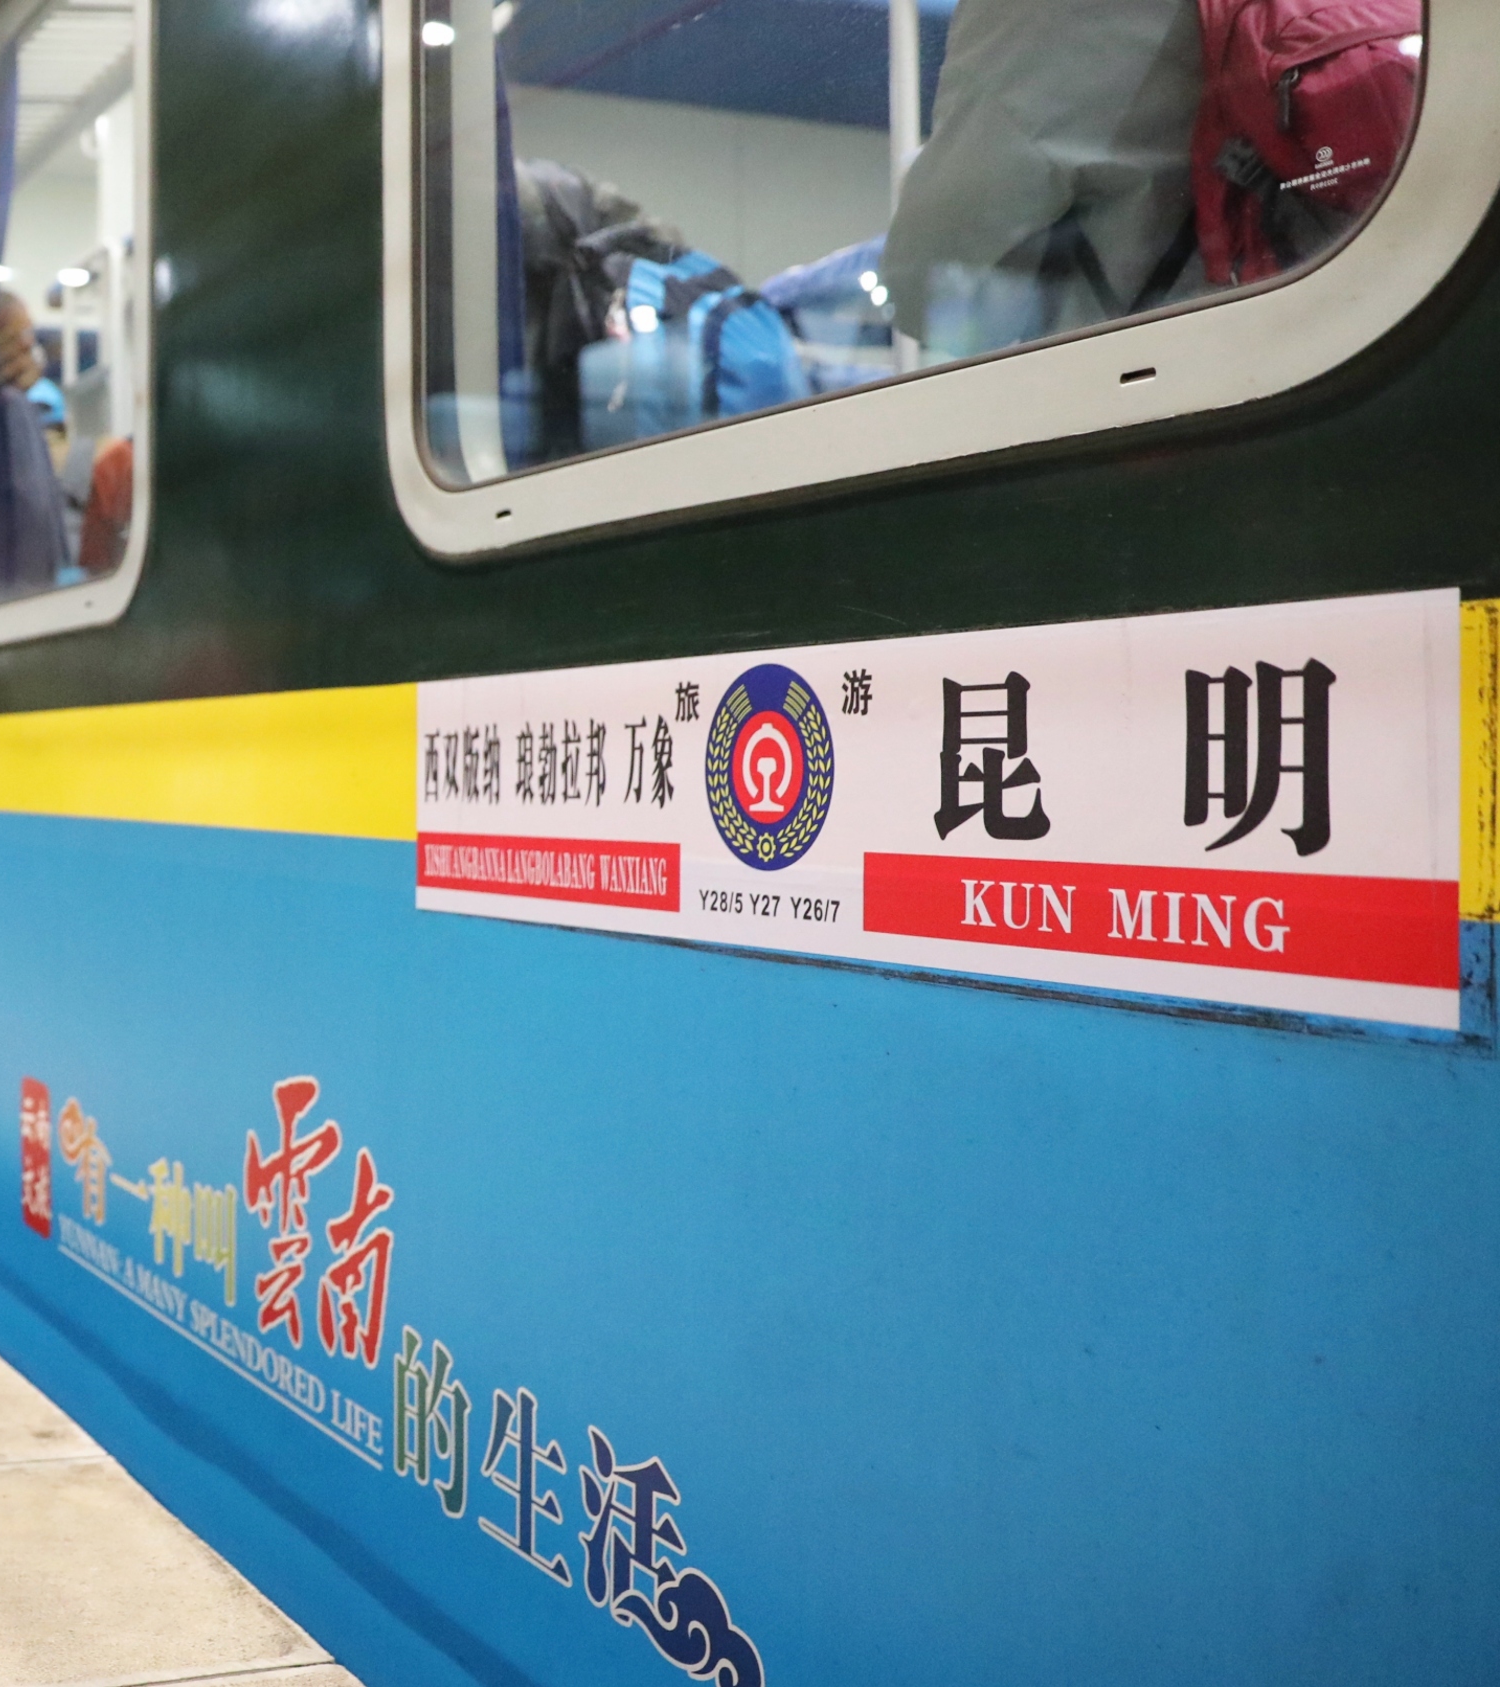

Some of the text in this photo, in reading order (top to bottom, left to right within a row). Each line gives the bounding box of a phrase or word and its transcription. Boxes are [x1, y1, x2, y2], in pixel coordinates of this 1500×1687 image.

[675, 668, 873, 722] 旅 游
[424, 714, 675, 810] 西双版纳 琅勃拉邦 万象
[600, 855, 668, 897] WANXIANG
[699, 889, 841, 923] Y28/5 Y27 Y26/7
[960, 879, 1291, 953] KUN MING
[190, 1299, 326, 1413] SPLENDORED
[330, 1388, 384, 1457] LIFE
